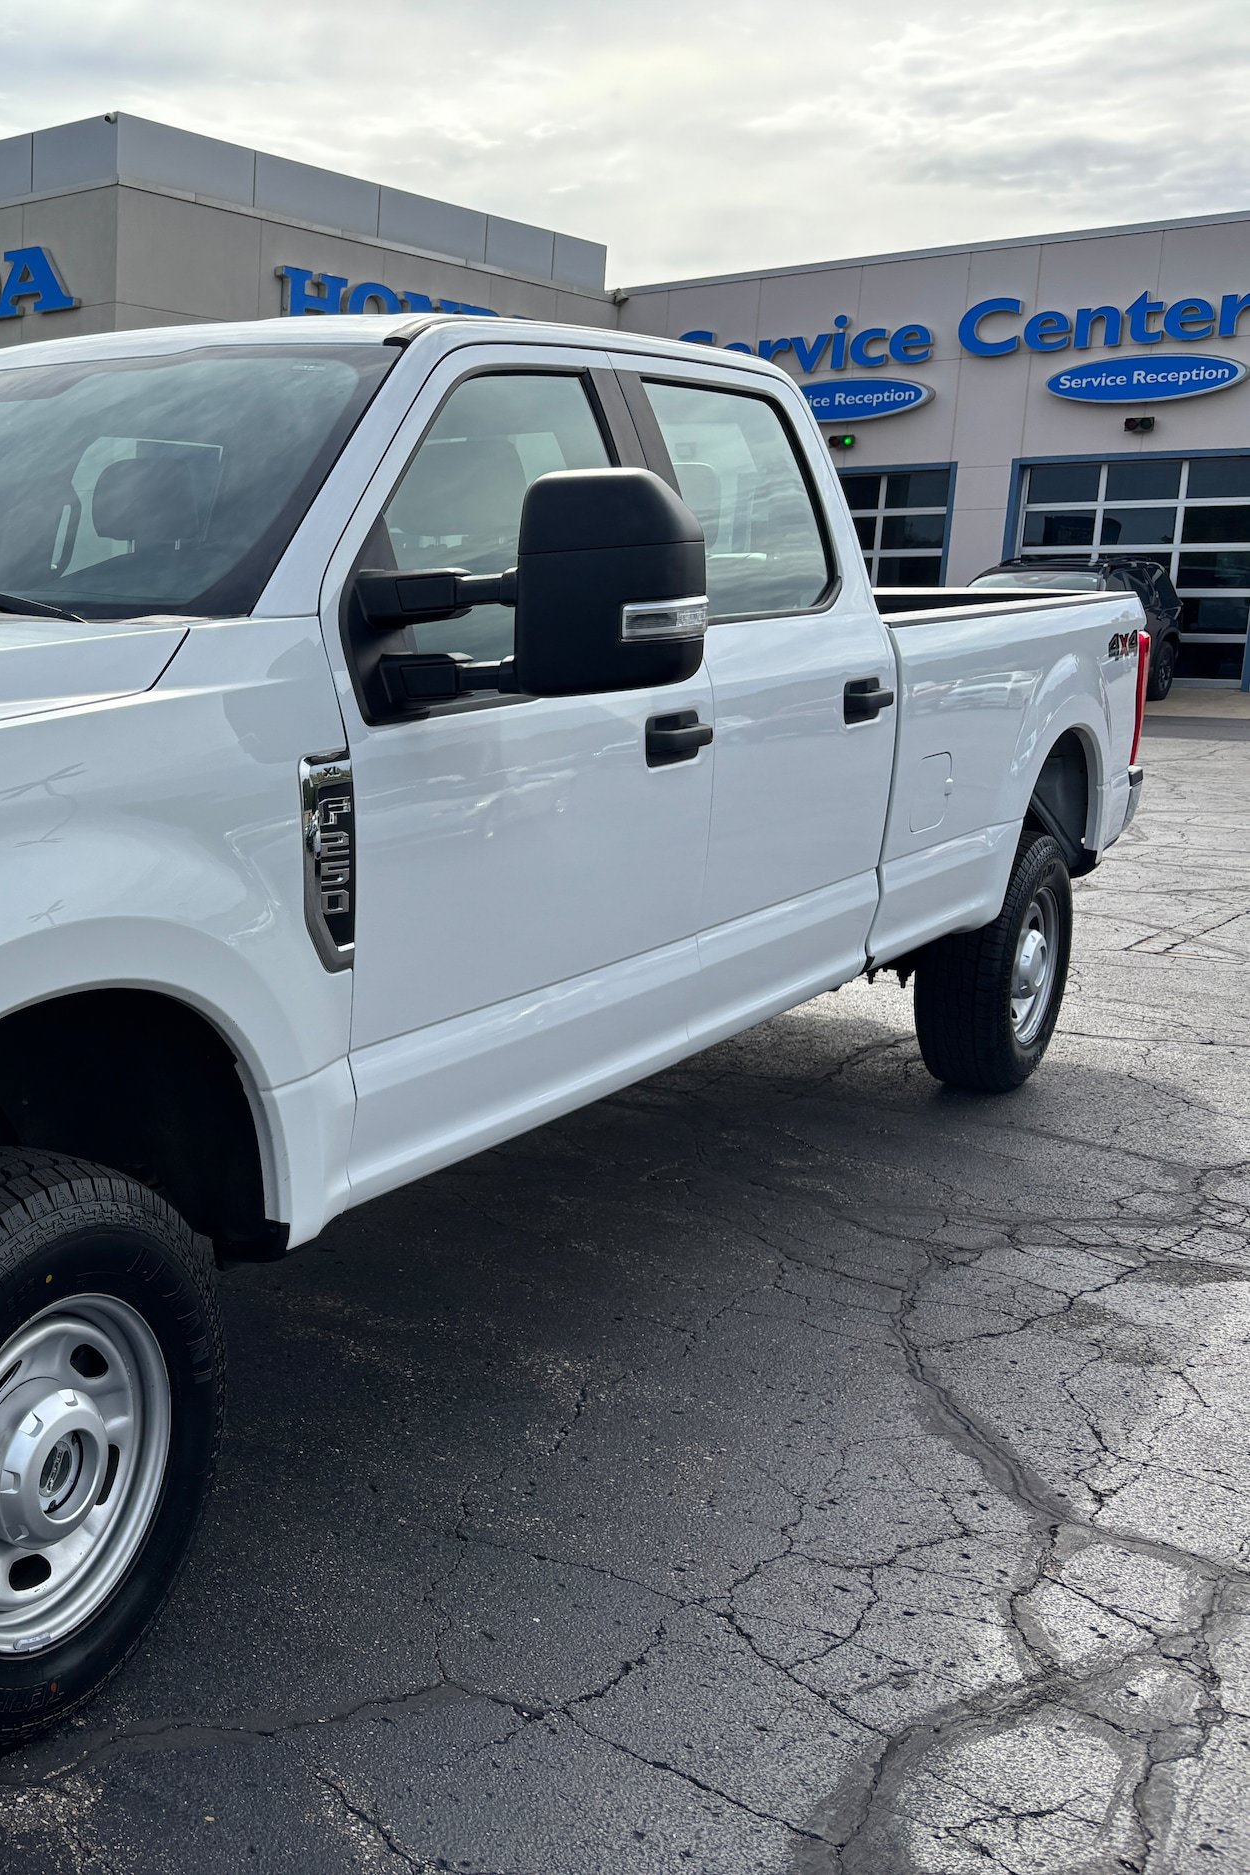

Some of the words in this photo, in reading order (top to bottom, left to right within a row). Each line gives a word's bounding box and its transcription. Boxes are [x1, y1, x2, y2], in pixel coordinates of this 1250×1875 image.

[679, 315, 934, 374] rvice
[958, 290, 1250, 357] Center
[1058, 373, 1128, 390] Service
[1132, 366, 1230, 386] Reception
[834, 387, 916, 407] Reception
[323, 766, 341, 778] XL
